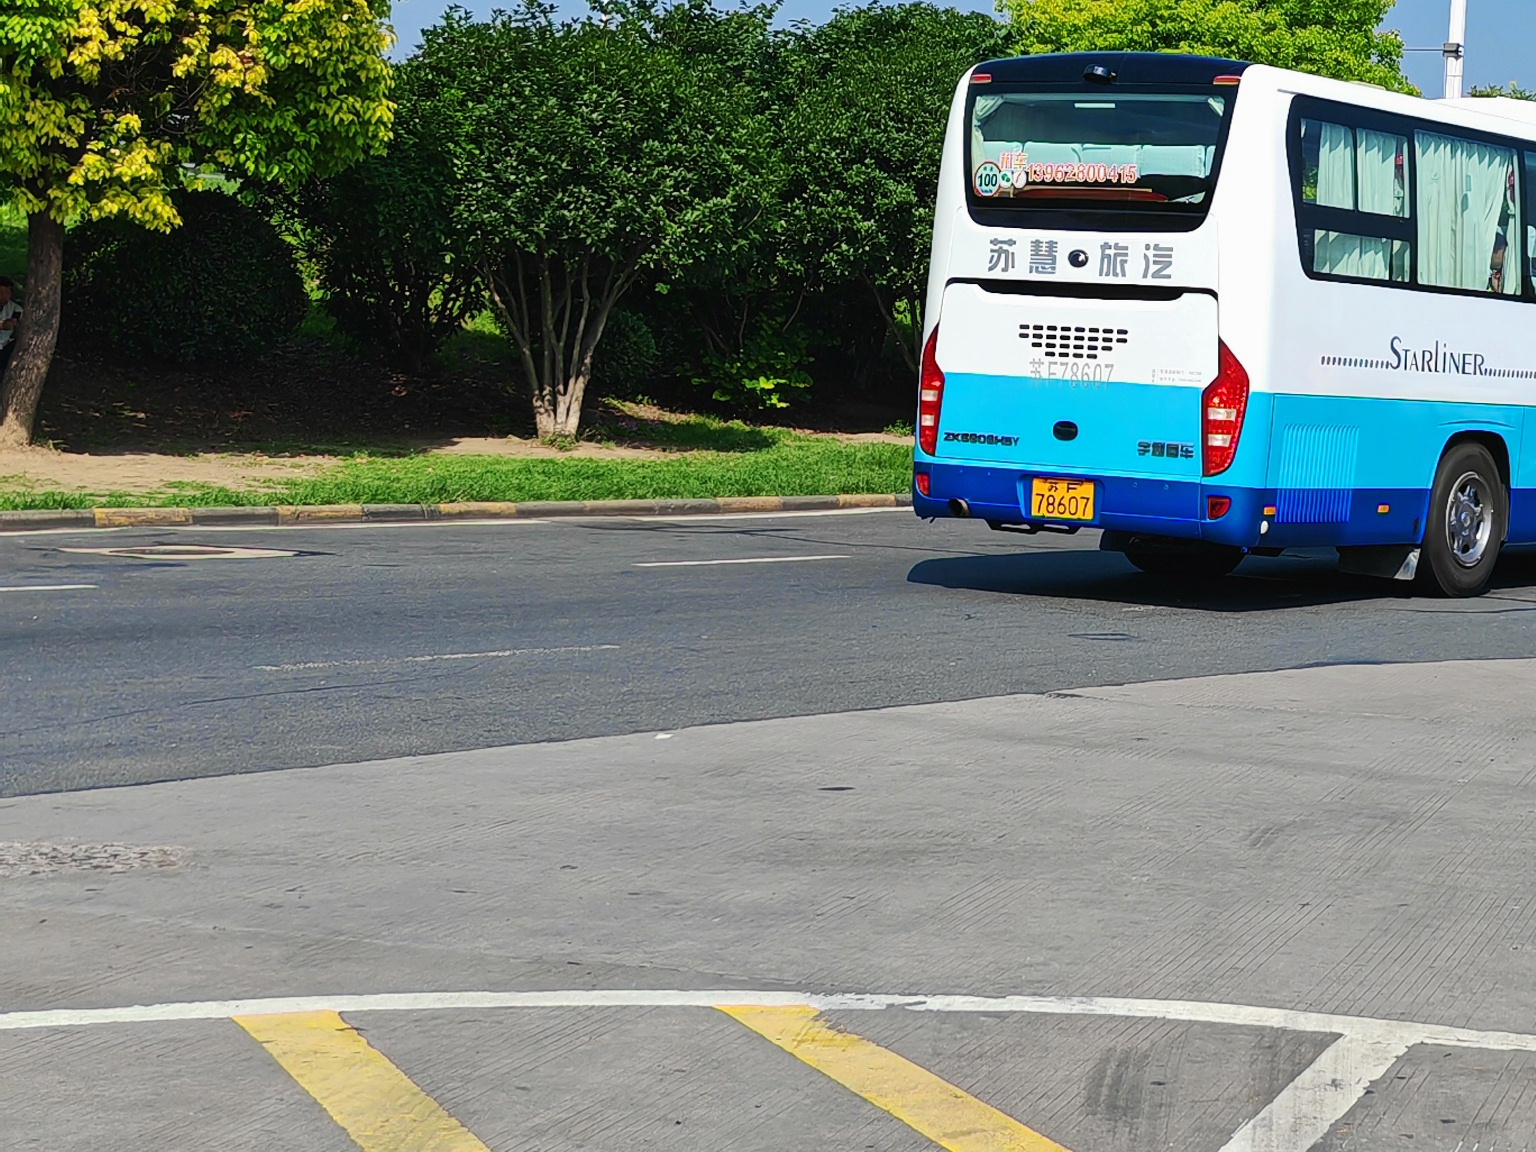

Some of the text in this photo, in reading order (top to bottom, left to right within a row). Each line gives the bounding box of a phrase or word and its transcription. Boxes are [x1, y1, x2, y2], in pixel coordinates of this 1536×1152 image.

[977, 173, 998, 187] 100
[1027, 162, 1137, 184] 13962800415
[1035, 493, 1091, 517] 78607
